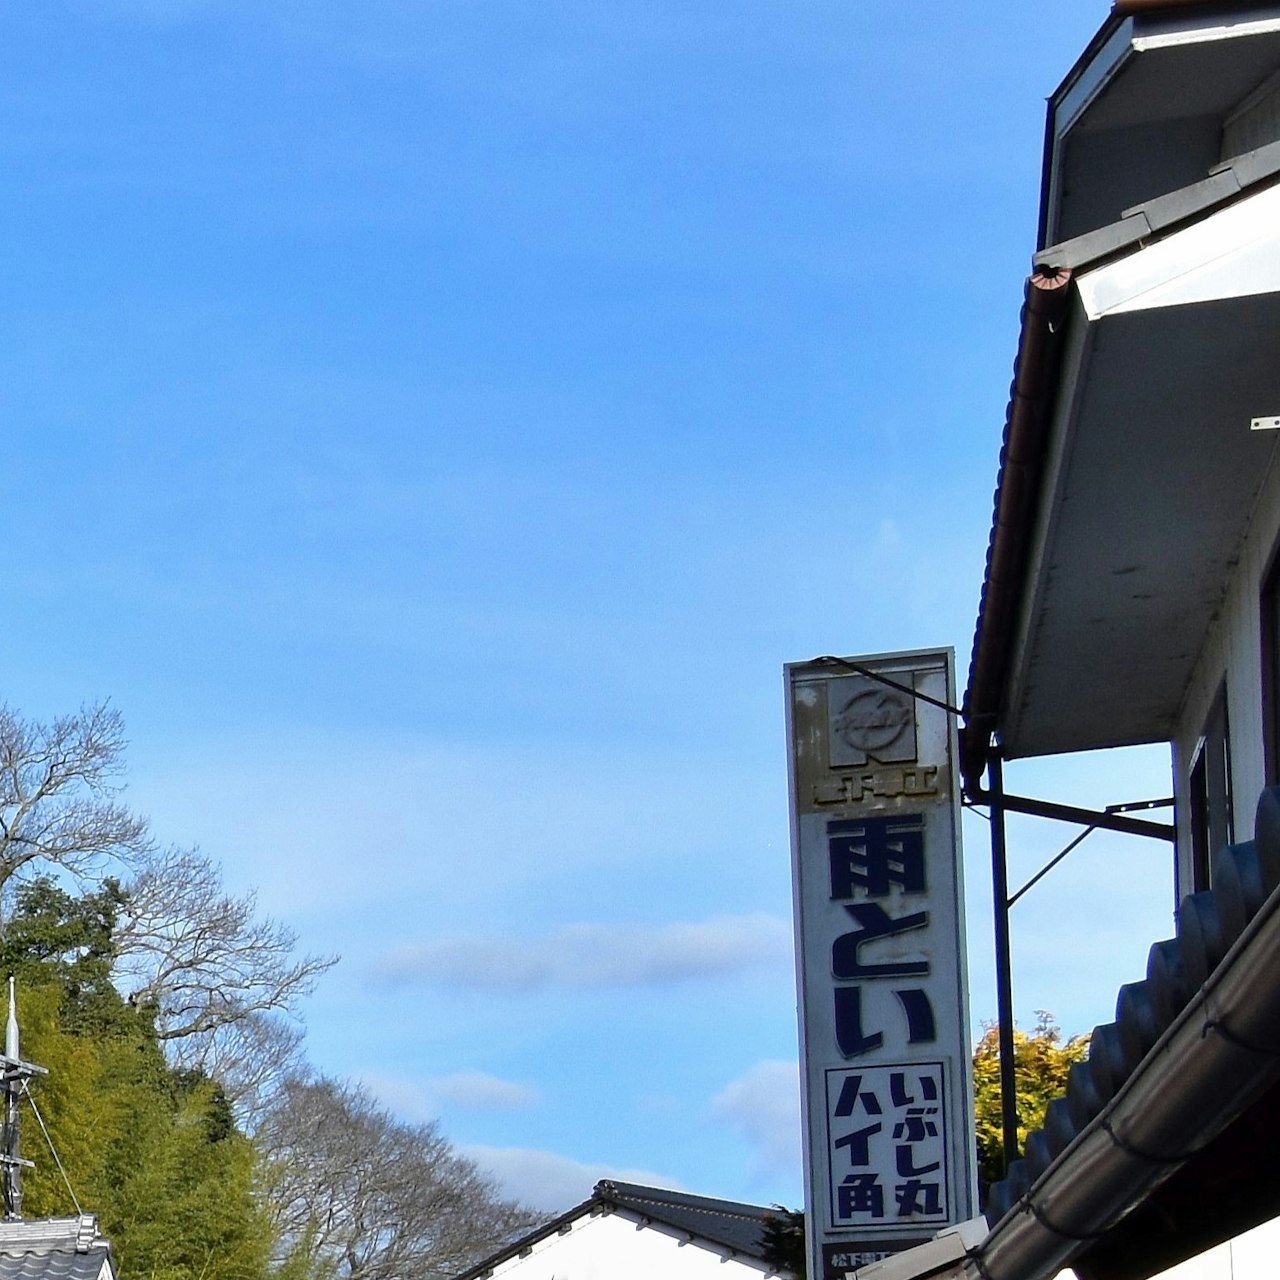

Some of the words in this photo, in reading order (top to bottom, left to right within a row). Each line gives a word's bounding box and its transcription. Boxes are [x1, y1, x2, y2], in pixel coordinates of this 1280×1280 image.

[828, 812, 938, 1062] 雨とい
[833, 1076, 884, 1219] ハイ角
[890, 1073, 944, 1218] いぶし丸
